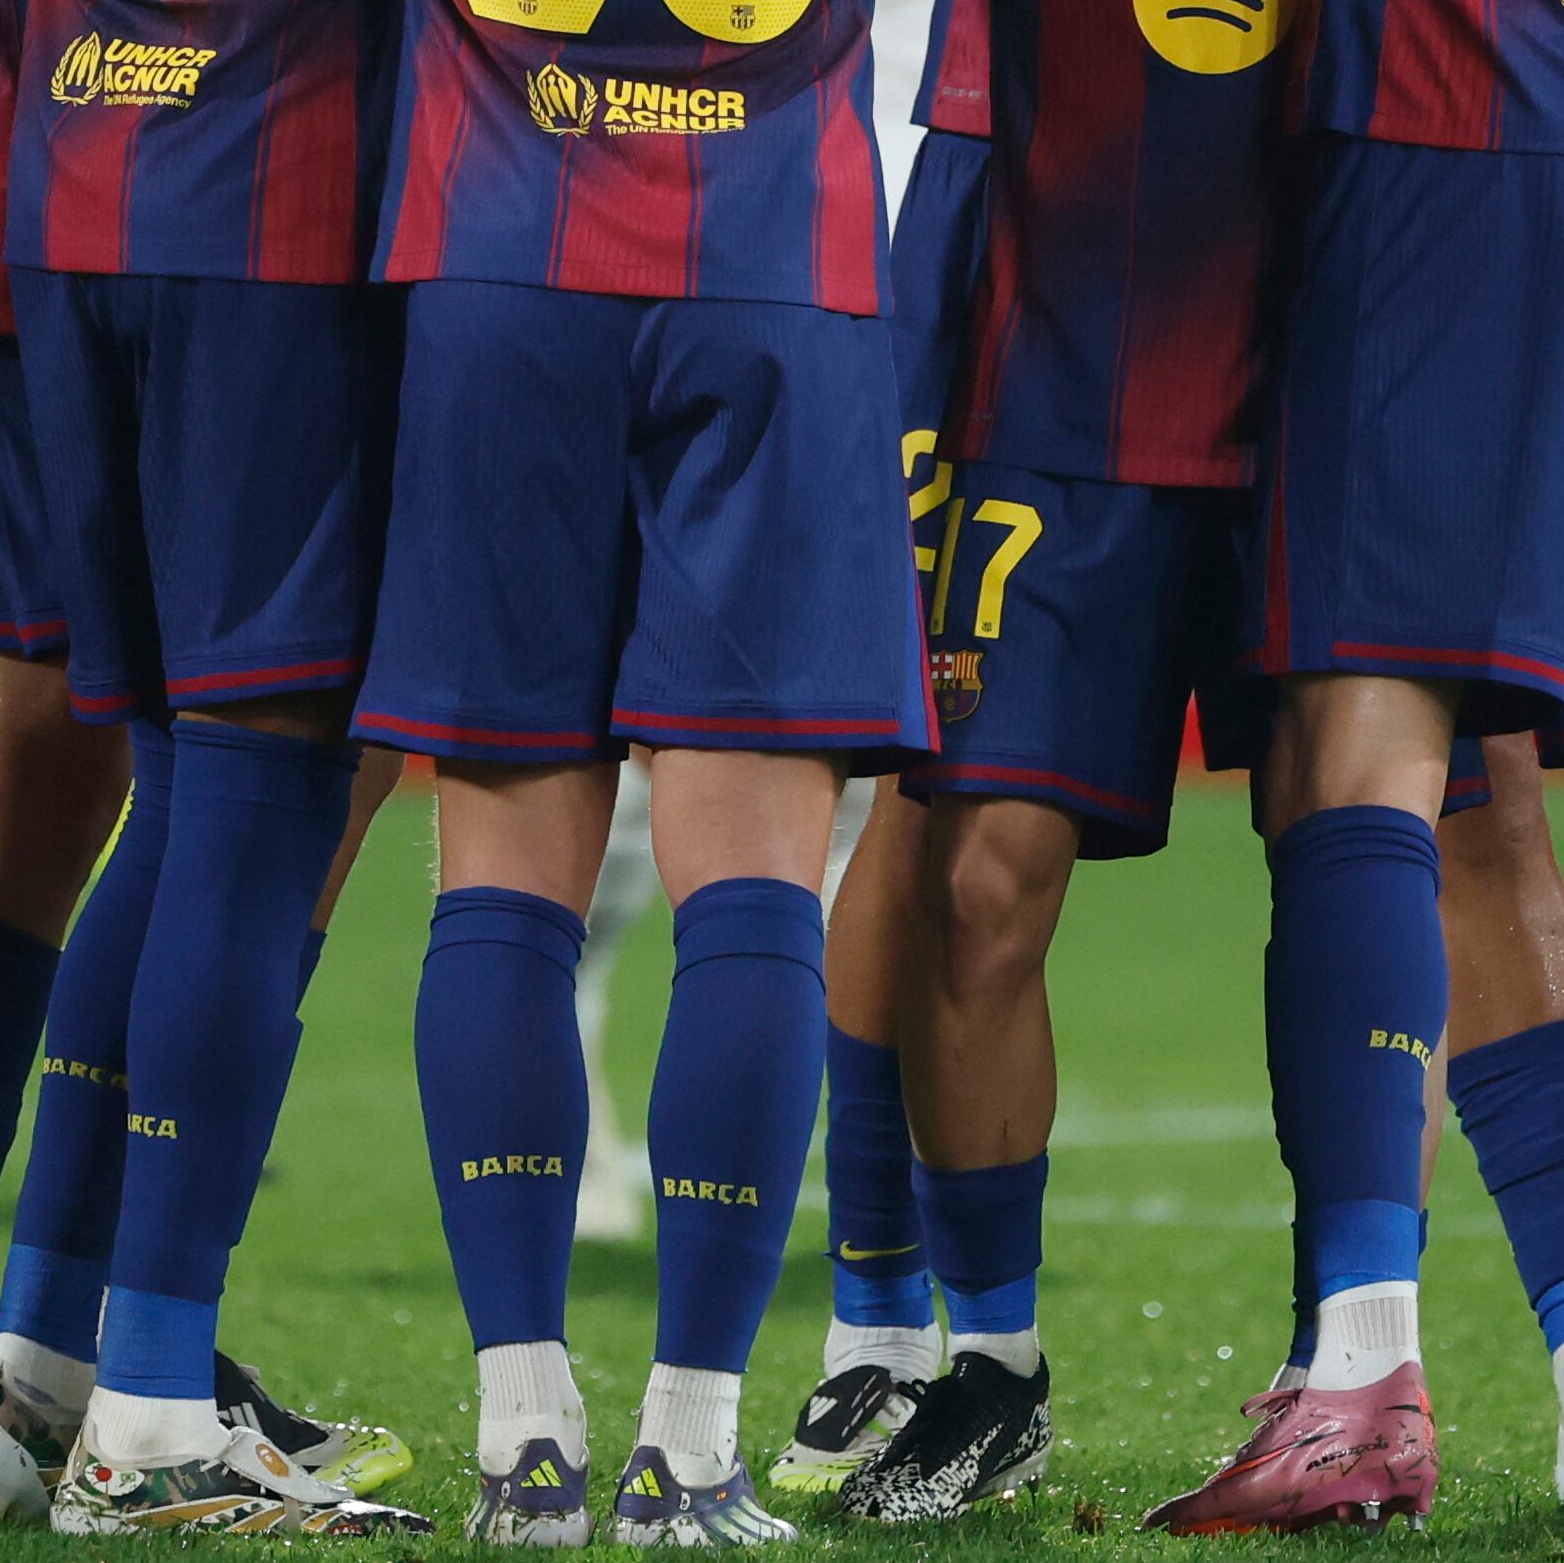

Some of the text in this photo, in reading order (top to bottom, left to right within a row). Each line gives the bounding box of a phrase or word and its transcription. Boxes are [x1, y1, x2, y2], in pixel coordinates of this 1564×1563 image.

[104, 38, 217, 68] UNHCR
[104, 63, 200, 96] ACNUR
[604, 78, 746, 118] UNHCR
[603, 105, 746, 131] ACNUR
[462, 1155, 563, 1182] BARÇA
[663, 1177, 759, 1207] BARÇA
